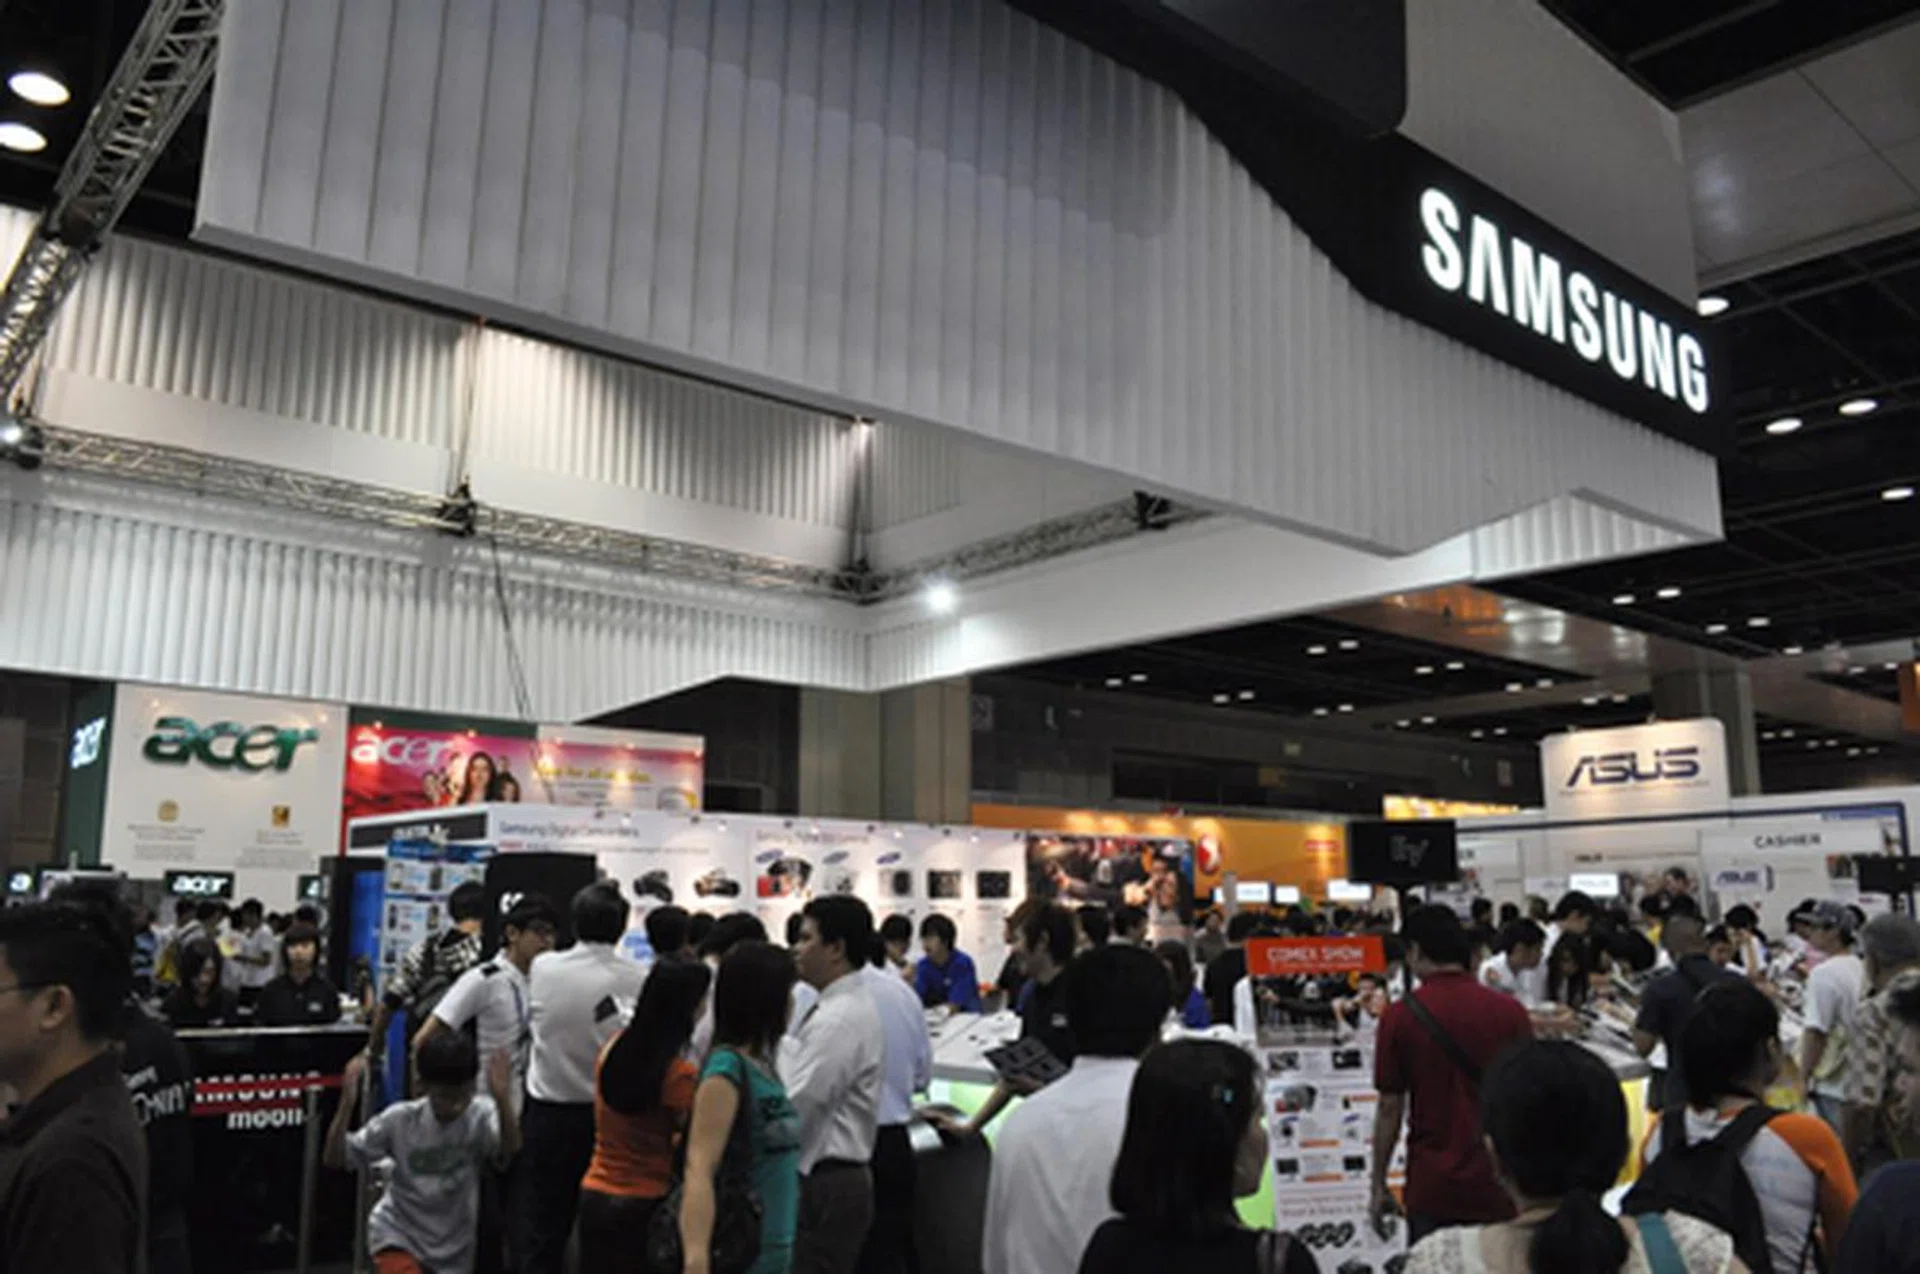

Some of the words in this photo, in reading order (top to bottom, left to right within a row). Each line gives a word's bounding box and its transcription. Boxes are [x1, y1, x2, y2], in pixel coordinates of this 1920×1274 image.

[1420, 187, 1708, 414] SAMSUNG
[142, 716, 320, 774] acer
[351, 733, 453, 767] acer
[1566, 746, 1699, 787] ASUS
[1754, 833, 1822, 848] CASHIER
[172, 874, 228, 894] acer
